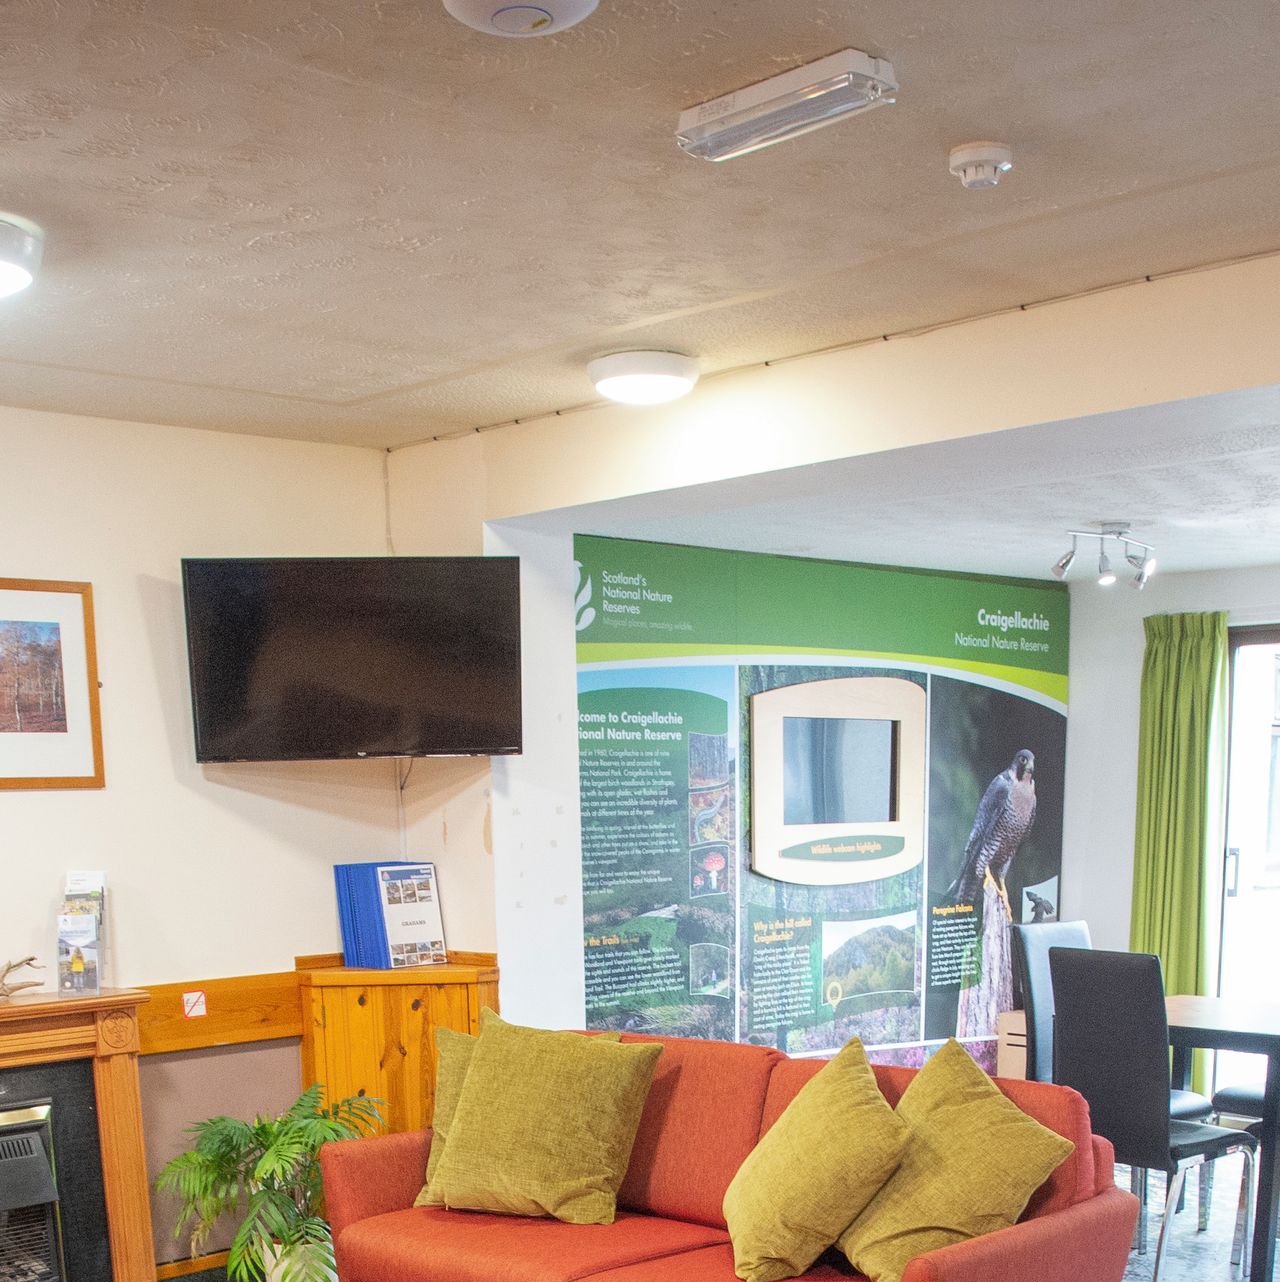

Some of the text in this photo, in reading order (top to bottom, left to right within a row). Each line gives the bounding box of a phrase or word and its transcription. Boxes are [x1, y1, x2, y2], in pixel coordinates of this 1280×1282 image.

[602, 570, 647, 587] Scotland's
[602, 586, 673, 603] National Nature
[602, 600, 640, 615] Reserves
[977, 608, 1050, 632] Craigellachie
[955, 632, 1050, 652] National Nature Reserve
[578, 711, 684, 727] come to Craigellachie
[607, 728, 642, 740] Nature
[644, 729, 683, 741] Reserve
[609, 749, 639, 759] Craigellachie
[582, 759, 599, 767] Nature
[589, 769, 610, 777] National
[623, 769, 653, 779] Craigellachie
[856, 840, 882, 855] highlights
[599, 878, 626, 887] Craigellachie
[933, 903, 974, 917] Peregrine Falcons
[753, 920, 768, 936] Why
[774, 919, 785, 930] the
[785, 918, 794, 929] hill
[795, 916, 812, 929] called
[589, 936, 600, 947] the
[602, 934, 620, 946] Trails
[753, 930, 794, 945] Craigellachie?
